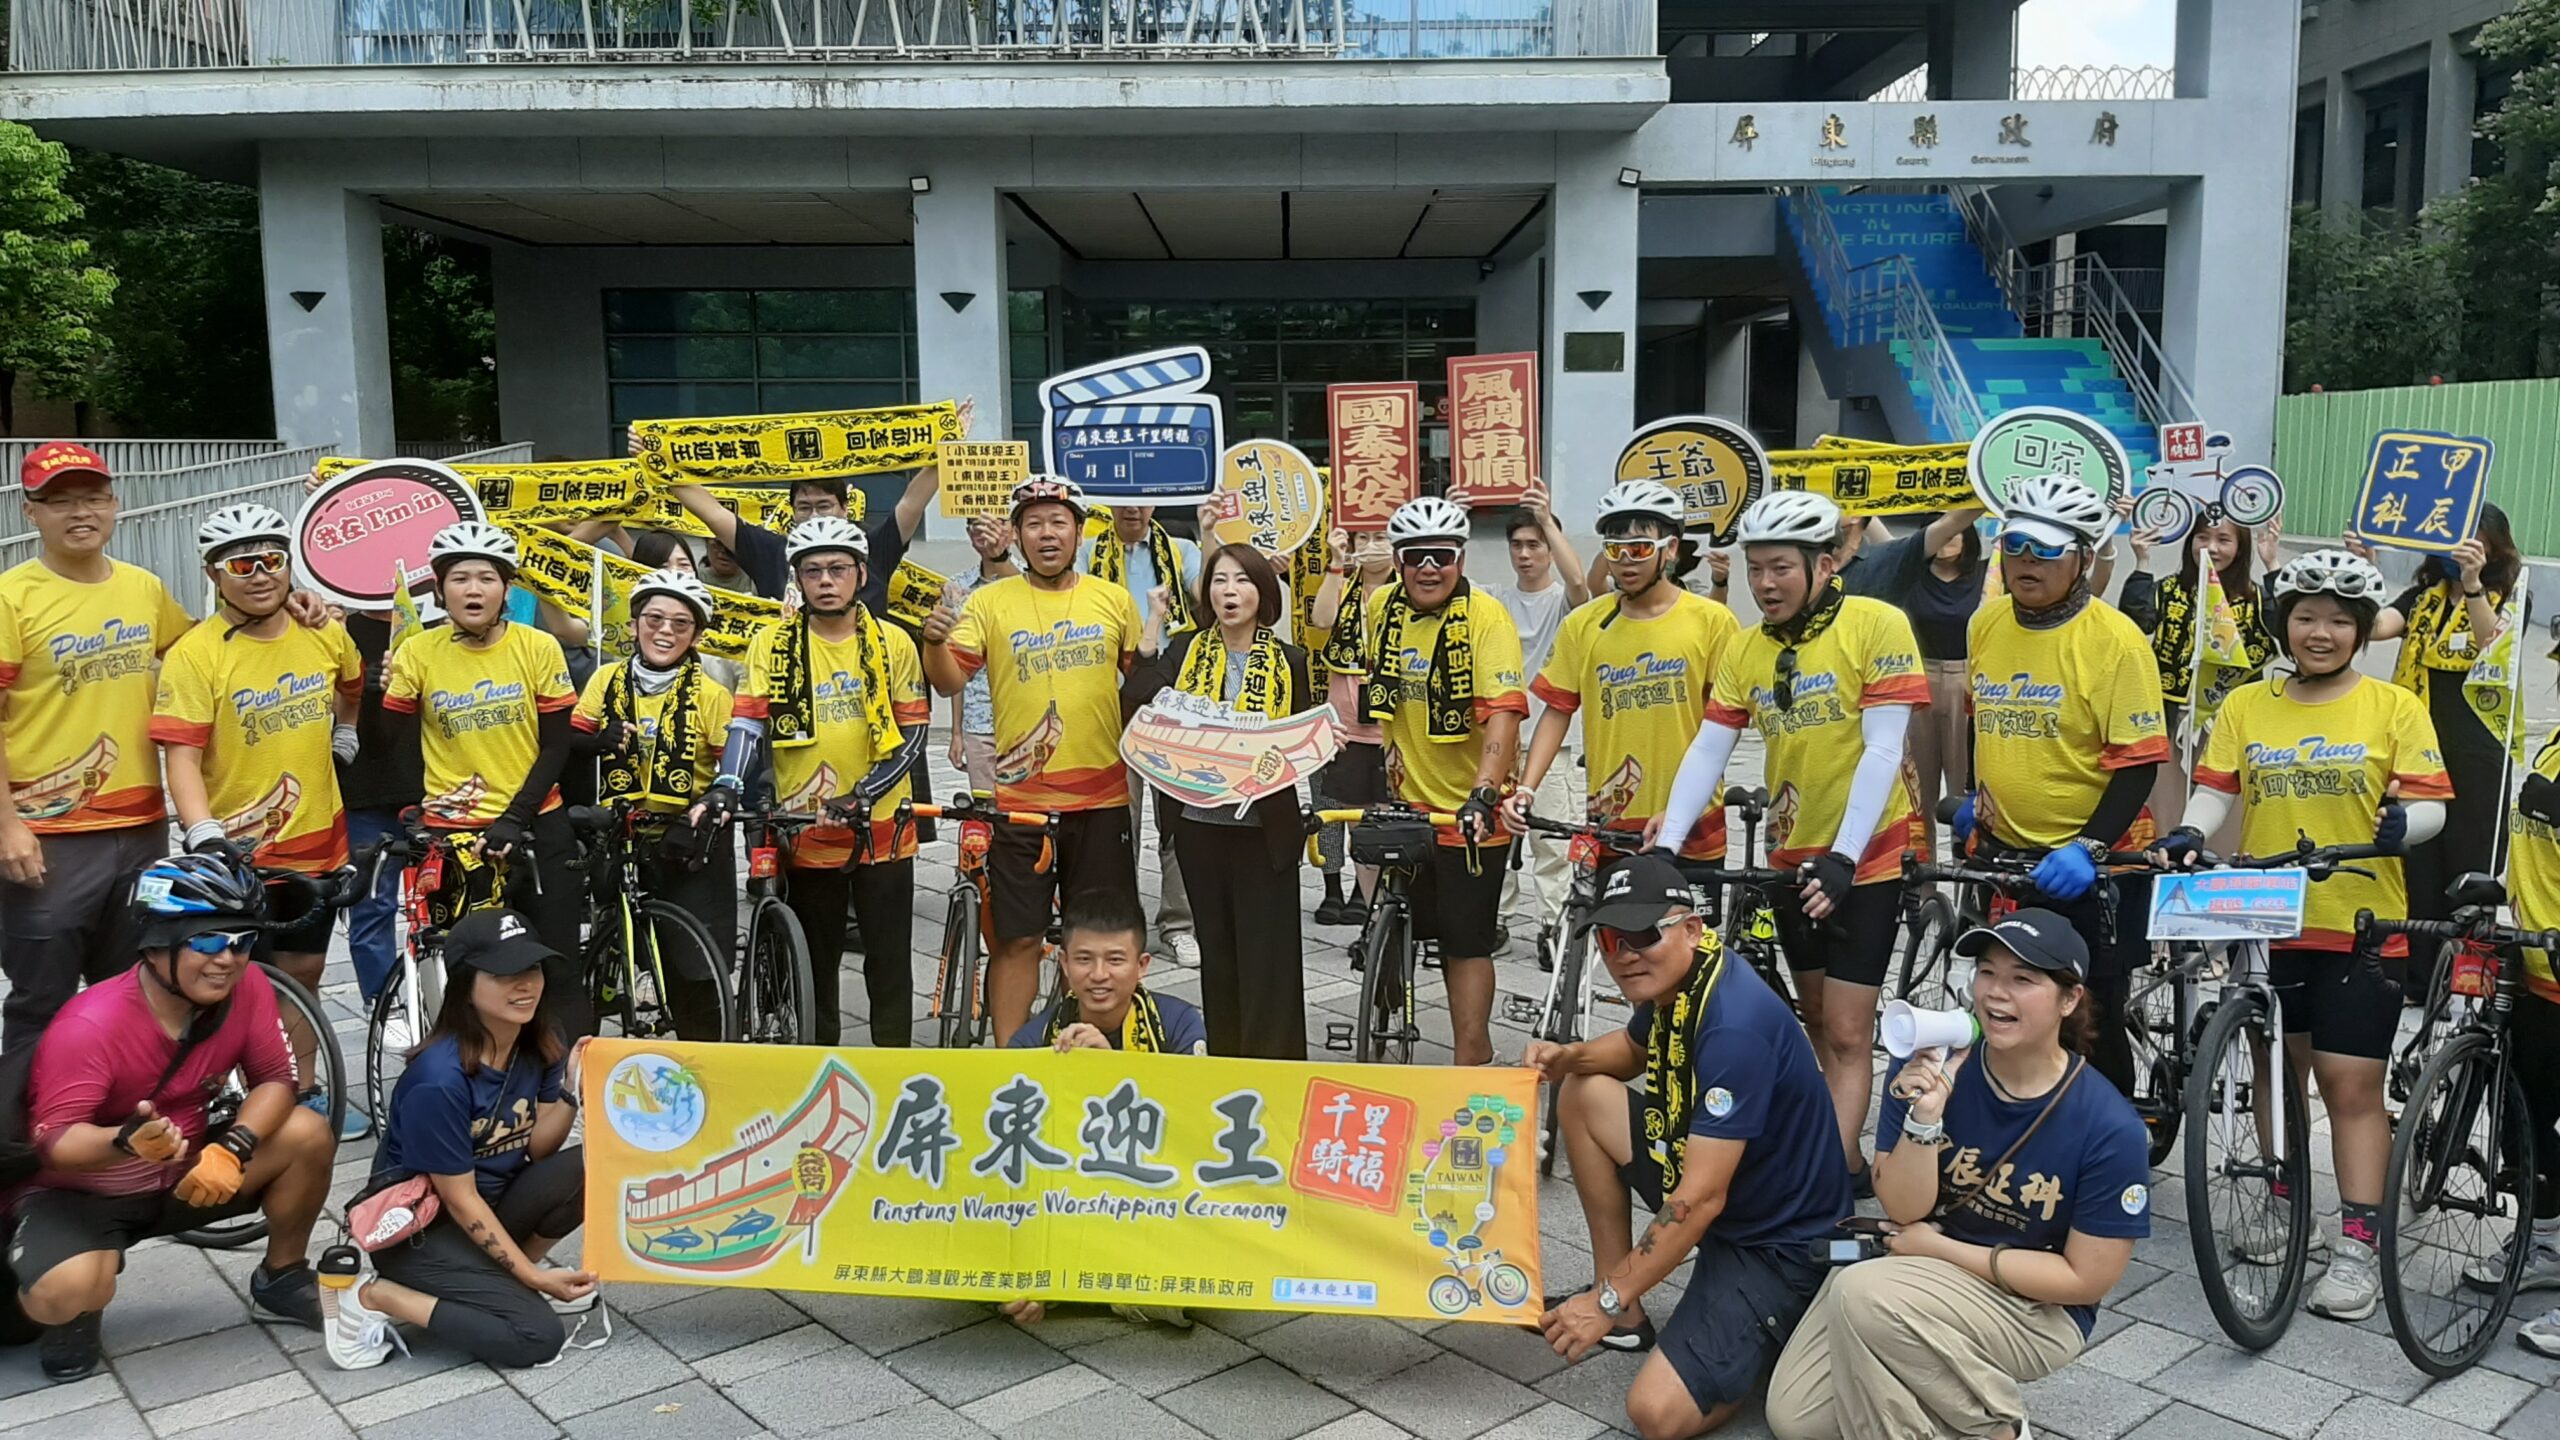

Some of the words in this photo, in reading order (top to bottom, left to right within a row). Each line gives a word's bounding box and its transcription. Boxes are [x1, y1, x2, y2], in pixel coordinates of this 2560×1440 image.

[1728, 111, 2119, 152] 屏東縣政府
[1861, 232, 1963, 245] FUTURE
[1460, 369, 1528, 488] 風調雨順
[1086, 464, 1097, 478] 月
[1114, 465, 1126, 478] 日
[1340, 396, 1408, 518] 國泰民安
[1646, 441, 1716, 480] 王爺
[2014, 435, 2084, 477] 回家
[1674, 480, 1728, 509] 援團
[1896, 467, 1968, 490] 回家迎
[411, 490, 444, 513] in
[1236, 447, 1278, 551] 屏東迎王
[49, 634, 107, 663] Ping
[103, 618, 151, 643] Tung
[1010, 629, 1055, 654] Ping
[1053, 619, 1103, 643] Tung
[769, 626, 792, 704] 家迎王
[1312, 651, 1330, 705] 屏東迎
[1595, 663, 1638, 687] Ping
[1635, 651, 1686, 676] Tung
[231, 687, 281, 716] Ping
[276, 671, 326, 695] Tung
[430, 689, 476, 713] Ping
[473, 679, 525, 700] Tung
[1156, 688, 1231, 722] 屏東迎王
[2010, 672, 2064, 701] Tung
[2245, 742, 2298, 770] Ping
[2299, 735, 2368, 761] Tung
[878, 1077, 1279, 1185] 屏東迎王
[1322, 1091, 1390, 1146] 千里
[1306, 1138, 1386, 1192] 騎福
[1436, 1172, 1483, 1183] TAIWAN
[1944, 1145, 2064, 1221] 辰正科
[873, 1198, 956, 1222] Pingtung
[963, 1196, 1037, 1227] Wangye
[1045, 1188, 1177, 1221] Worshipping
[1185, 1192, 1288, 1229] Ceremony
[834, 1264, 1052, 1290] 屏東縣大鵬灣觀光產業聯盟
